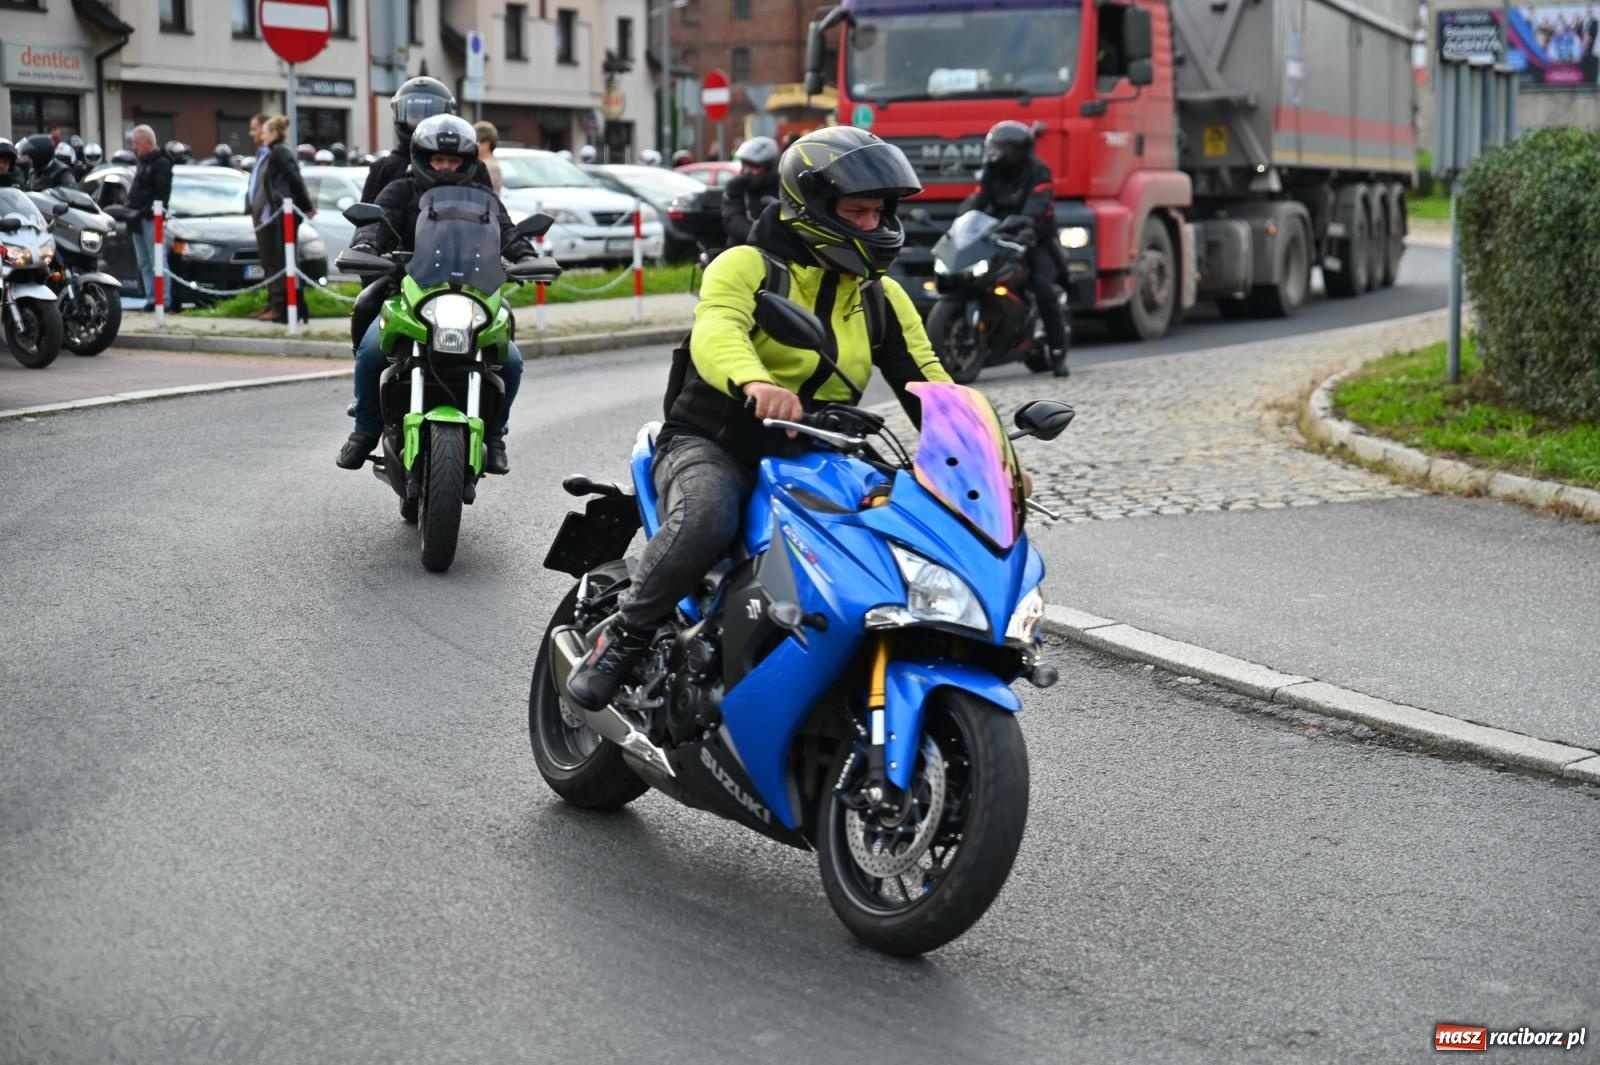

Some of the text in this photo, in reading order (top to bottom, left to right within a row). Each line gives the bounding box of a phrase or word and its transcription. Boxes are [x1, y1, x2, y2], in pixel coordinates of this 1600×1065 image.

[21, 45, 80, 71] dentica
[921, 143, 981, 158] MAN
[700, 746, 771, 824] SUZUKI
